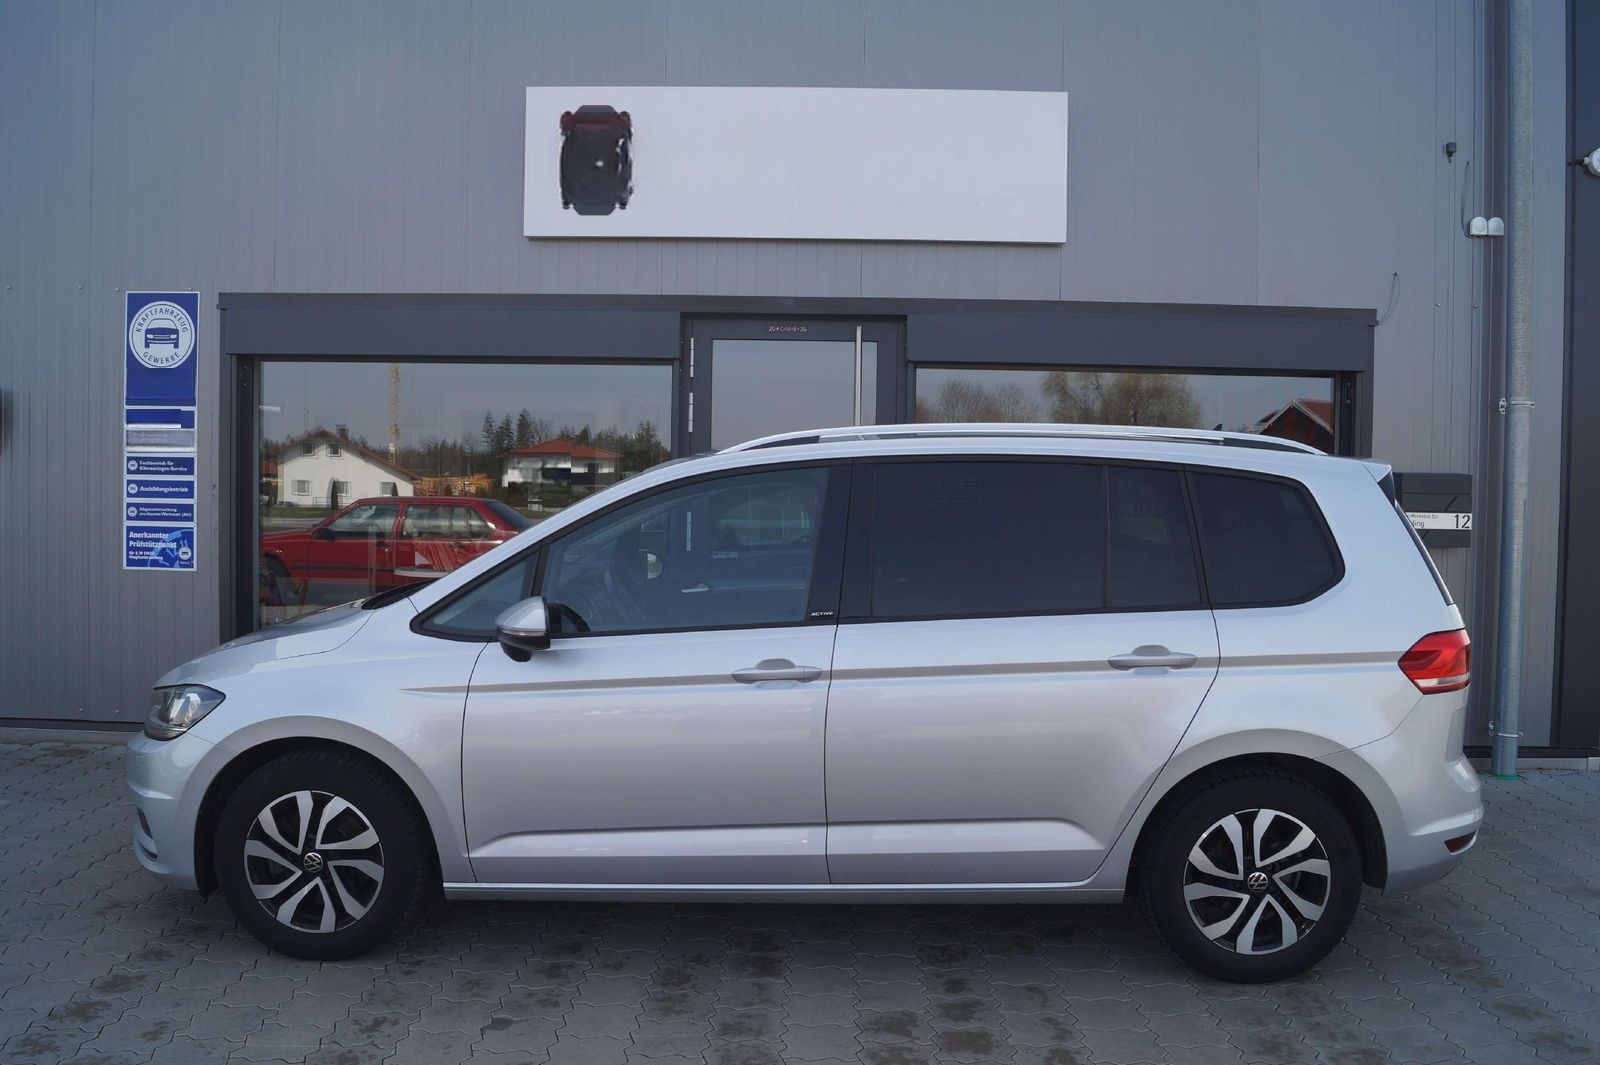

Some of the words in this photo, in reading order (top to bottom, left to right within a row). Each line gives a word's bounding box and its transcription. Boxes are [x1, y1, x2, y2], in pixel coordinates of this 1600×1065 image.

[135, 307, 189, 333] KRAFTFAHRZEUG
[143, 351, 180, 364] GEWERBE
[1454, 514, 1471, 529] 12
[129, 531, 169, 539] Anerkannter
[129, 540, 178, 549] Prüfstützpunkt
